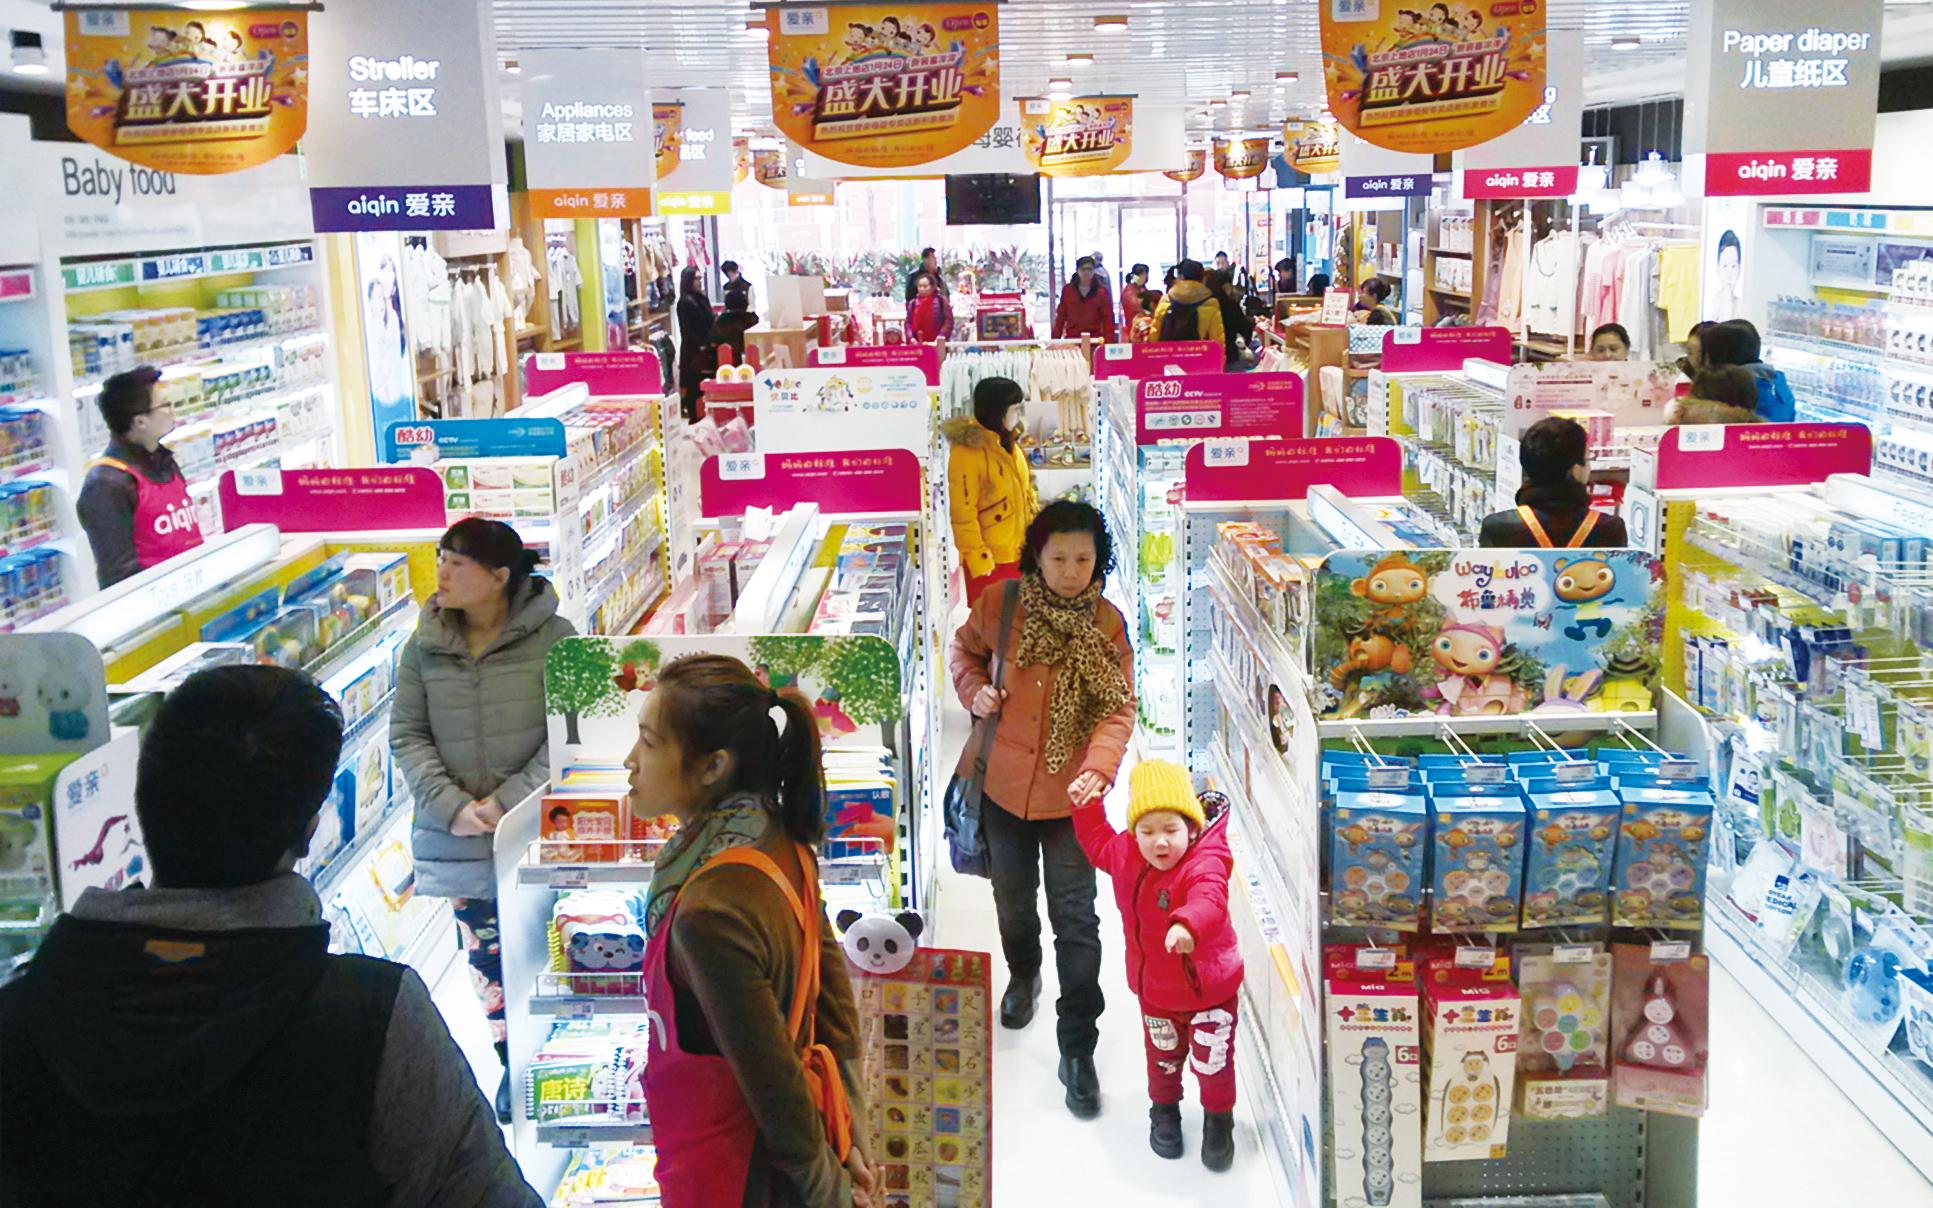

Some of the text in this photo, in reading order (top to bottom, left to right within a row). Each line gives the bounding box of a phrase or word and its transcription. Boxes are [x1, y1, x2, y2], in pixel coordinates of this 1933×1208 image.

[1723, 28, 1870, 57] Paper diaper
[349, 56, 440, 81] Stroller
[1367, 53, 1506, 103] 盛大开业
[1740, 59, 1849, 88] 儿童纸区
[125, 76, 271, 120] 盛大开业
[348, 87, 437, 118] 车床区
[821, 68, 963, 116] 盛大开业
[541, 101, 633, 121] Appliances
[537, 123, 633, 144] 家居家电区
[1044, 129, 1116, 153] 盛大开业
[62, 157, 123, 204] Baby
[1486, 171, 1554, 188] aiqin 爱亲
[1738, 157, 1838, 181] aiqin 爱亲
[1362, 178, 1414, 191] aiqin 爱亲
[348, 192, 456, 217] aiqin 爱亲
[554, 192, 626, 210] aiqin 爱亲
[1145, 381, 1181, 398] 酷幼
[395, 427, 434, 444] 酷幼
[1210, 447, 1236, 460] 爱亲
[725, 459, 751, 473] 爱亲
[540, 1076, 588, 1101] 唐诗
